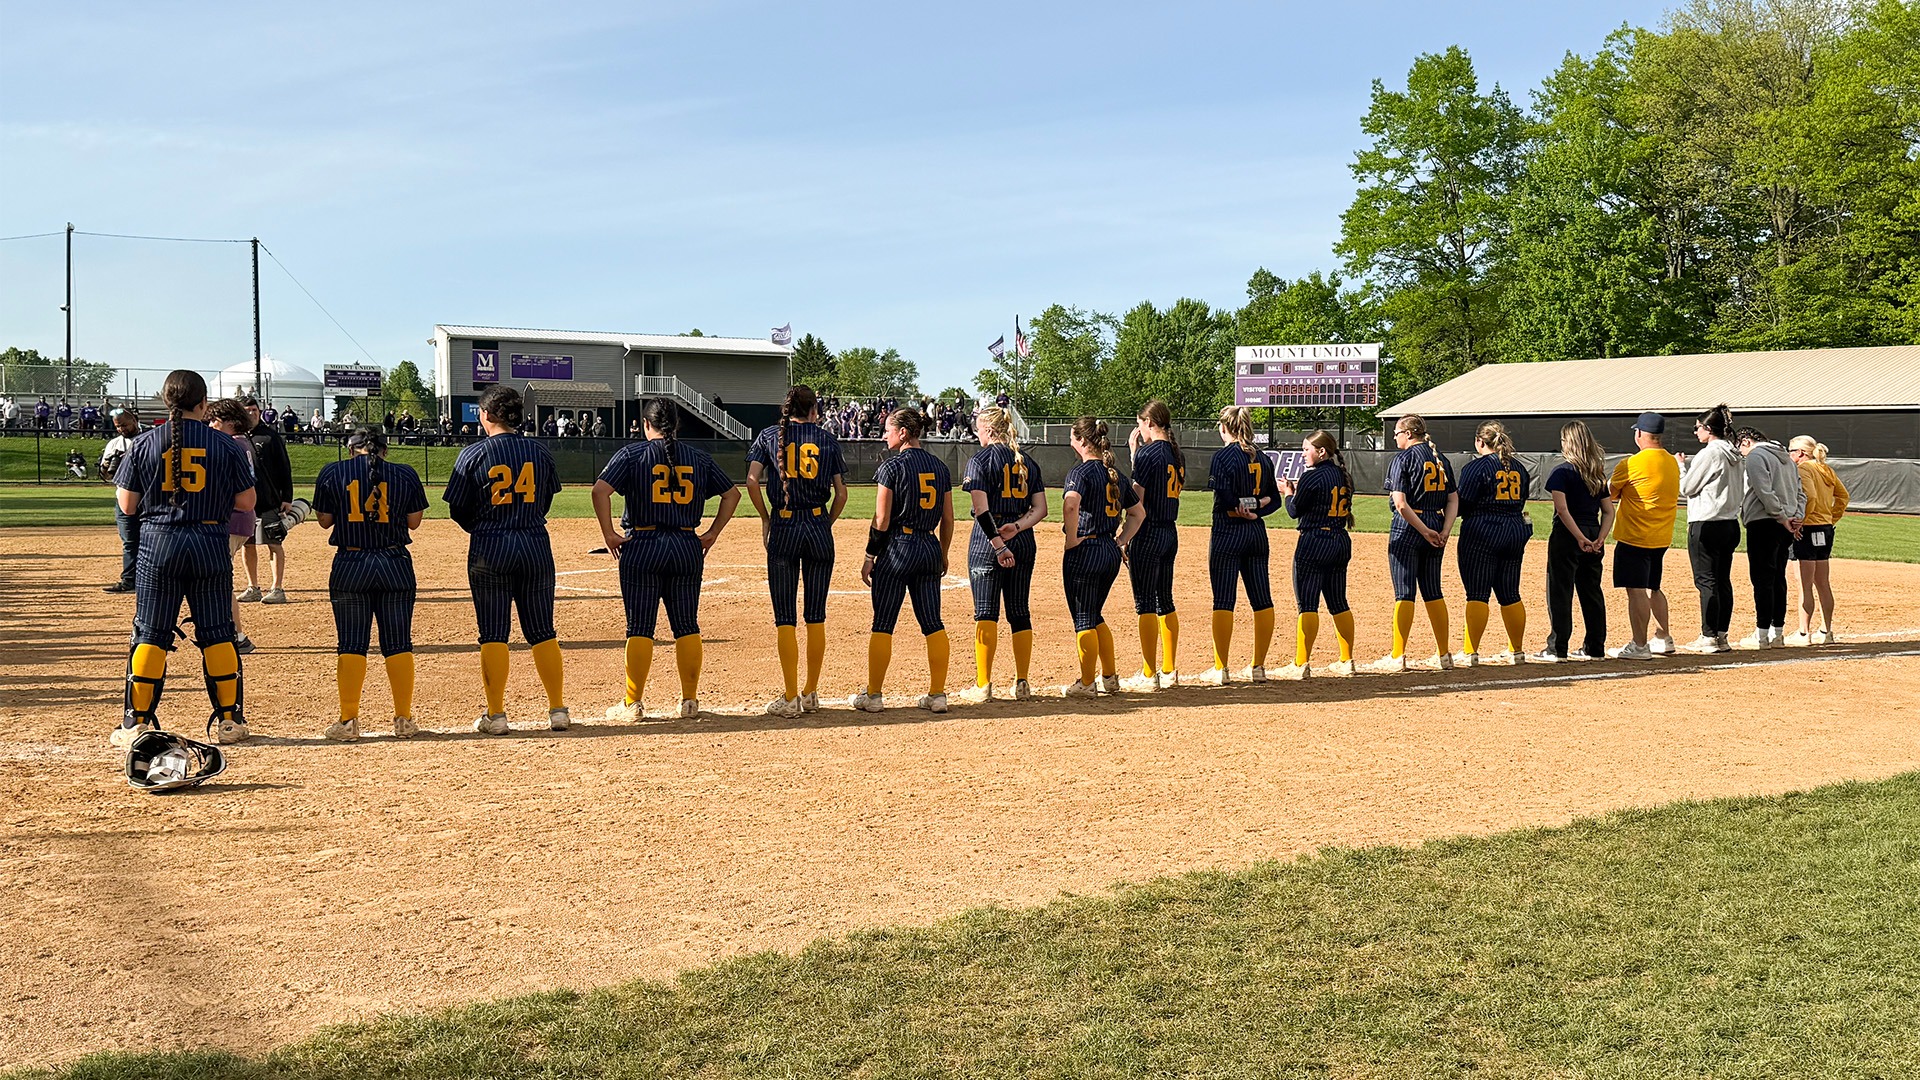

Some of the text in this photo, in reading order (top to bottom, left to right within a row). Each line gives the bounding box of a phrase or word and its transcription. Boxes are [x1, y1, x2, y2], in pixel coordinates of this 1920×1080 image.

[1252, 346, 1363, 358] MOUNT UNION
[161, 447, 207, 493] 15
[786, 442, 820, 480] 16
[1247, 462, 1262, 496] 7
[1423, 460, 1446, 492] 21
[487, 461, 536, 506] 24
[651, 463, 694, 505] 25
[918, 472, 937, 511] 5
[1001, 462, 1029, 499] 13
[1495, 469, 1521, 500] 28
[346, 479, 390, 524] 14
[1327, 485, 1349, 517] 12
